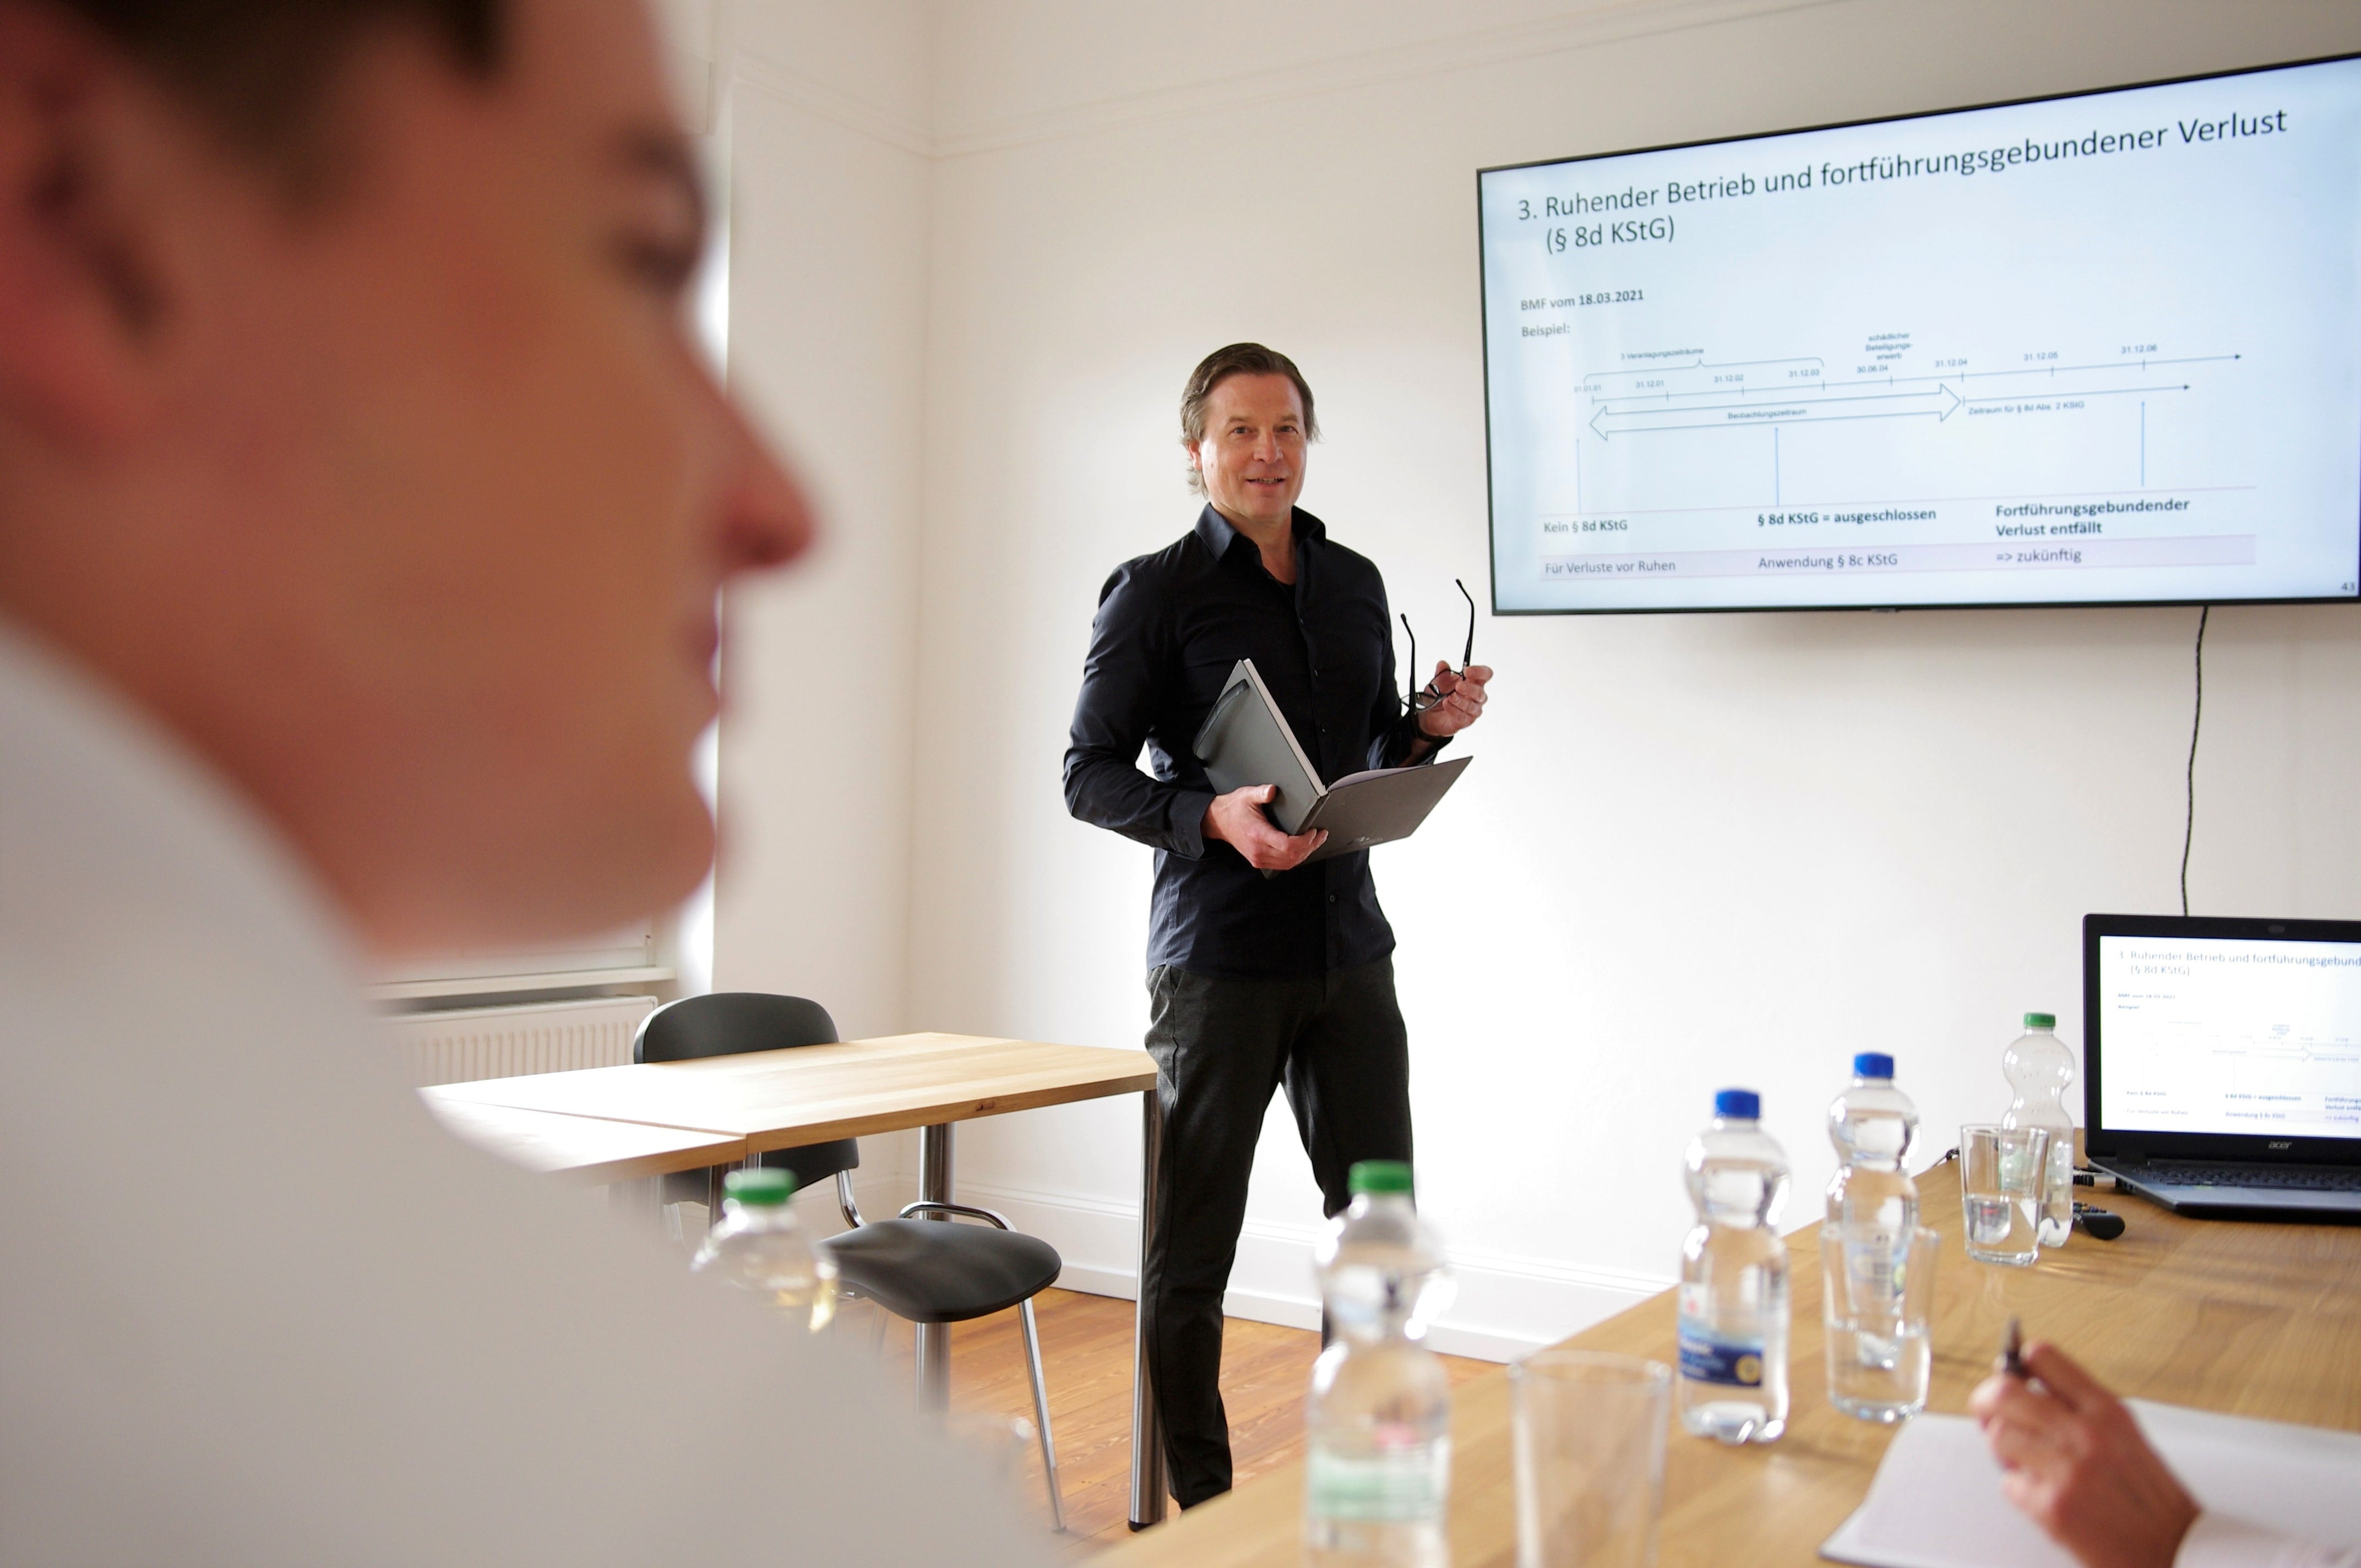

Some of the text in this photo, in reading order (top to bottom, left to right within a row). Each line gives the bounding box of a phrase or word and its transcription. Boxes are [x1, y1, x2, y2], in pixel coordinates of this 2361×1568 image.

[1518, 110, 2288, 220] 3. Ruhender Betrieb und fortführungsgebundener Verlust
[1547, 215, 1675, 254] (§ 8d KStG)
[1521, 289, 1644, 311] BMF vom 18.03.2021
[1522, 323, 1570, 337] Beispiel:
[1935, 358, 1967, 367] 31.12.04
[1968, 406, 2002, 415] Zeitraum
[2056, 402, 2061, 410] 2
[1996, 498, 2190, 517] Fortführungsgebundender
[1758, 514, 1764, 526] §
[1769, 513, 1784, 524] 8d
[1789, 512, 1819, 524] KStG
[1834, 509, 1937, 524] ausgeschlossen
[1544, 519, 1628, 533] Kein § 8d KStG
[1996, 521, 2102, 536] Verlust entfällt
[1759, 553, 1898, 569] Anwendung § 8c KStG
[2017, 549, 2082, 563] zukünftig
[1545, 560, 1675, 574] Für Verluste vor Ruhen
[2131, 951, 2183, 961] Ruhender
[2186, 952, 2225, 962] Betrieb
[2229, 954, 2249, 963] und
[2268, 1141, 2292, 1150] acer
